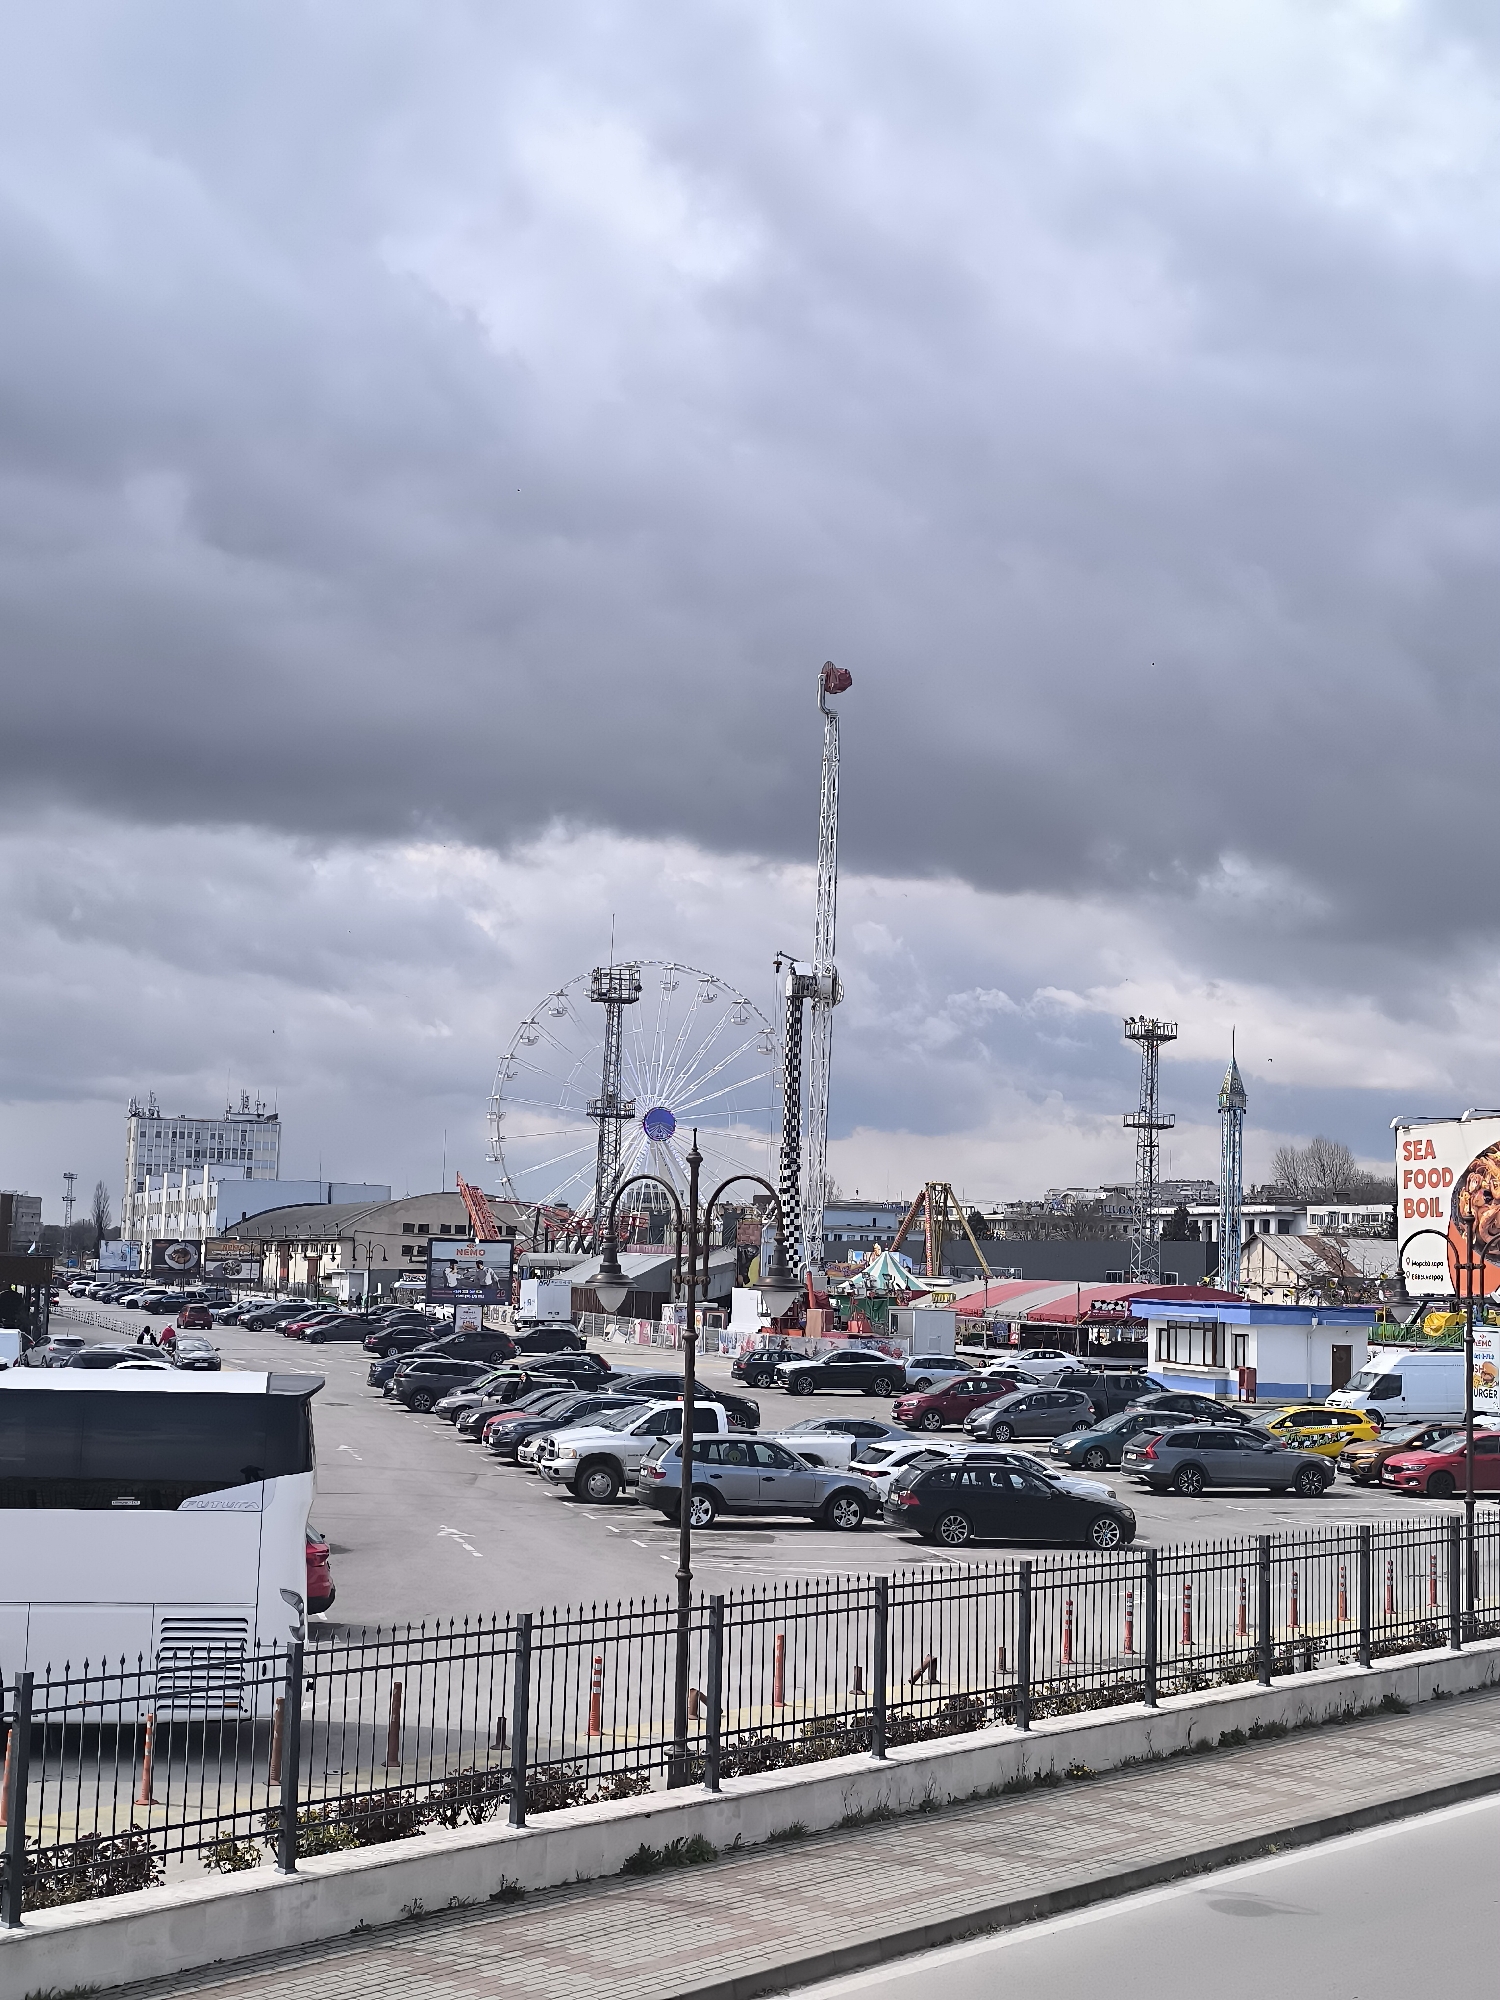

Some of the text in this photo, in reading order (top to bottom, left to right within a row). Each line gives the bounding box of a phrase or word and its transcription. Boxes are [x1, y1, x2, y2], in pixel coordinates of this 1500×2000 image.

[1403, 1139, 1436, 1161] SEA
[1403, 1167, 1453, 1189] FOOD
[1403, 1197, 1443, 1218] BOIL
[456, 1248, 486, 1256] NEMO
[1473, 1388, 1498, 1399] URGER
